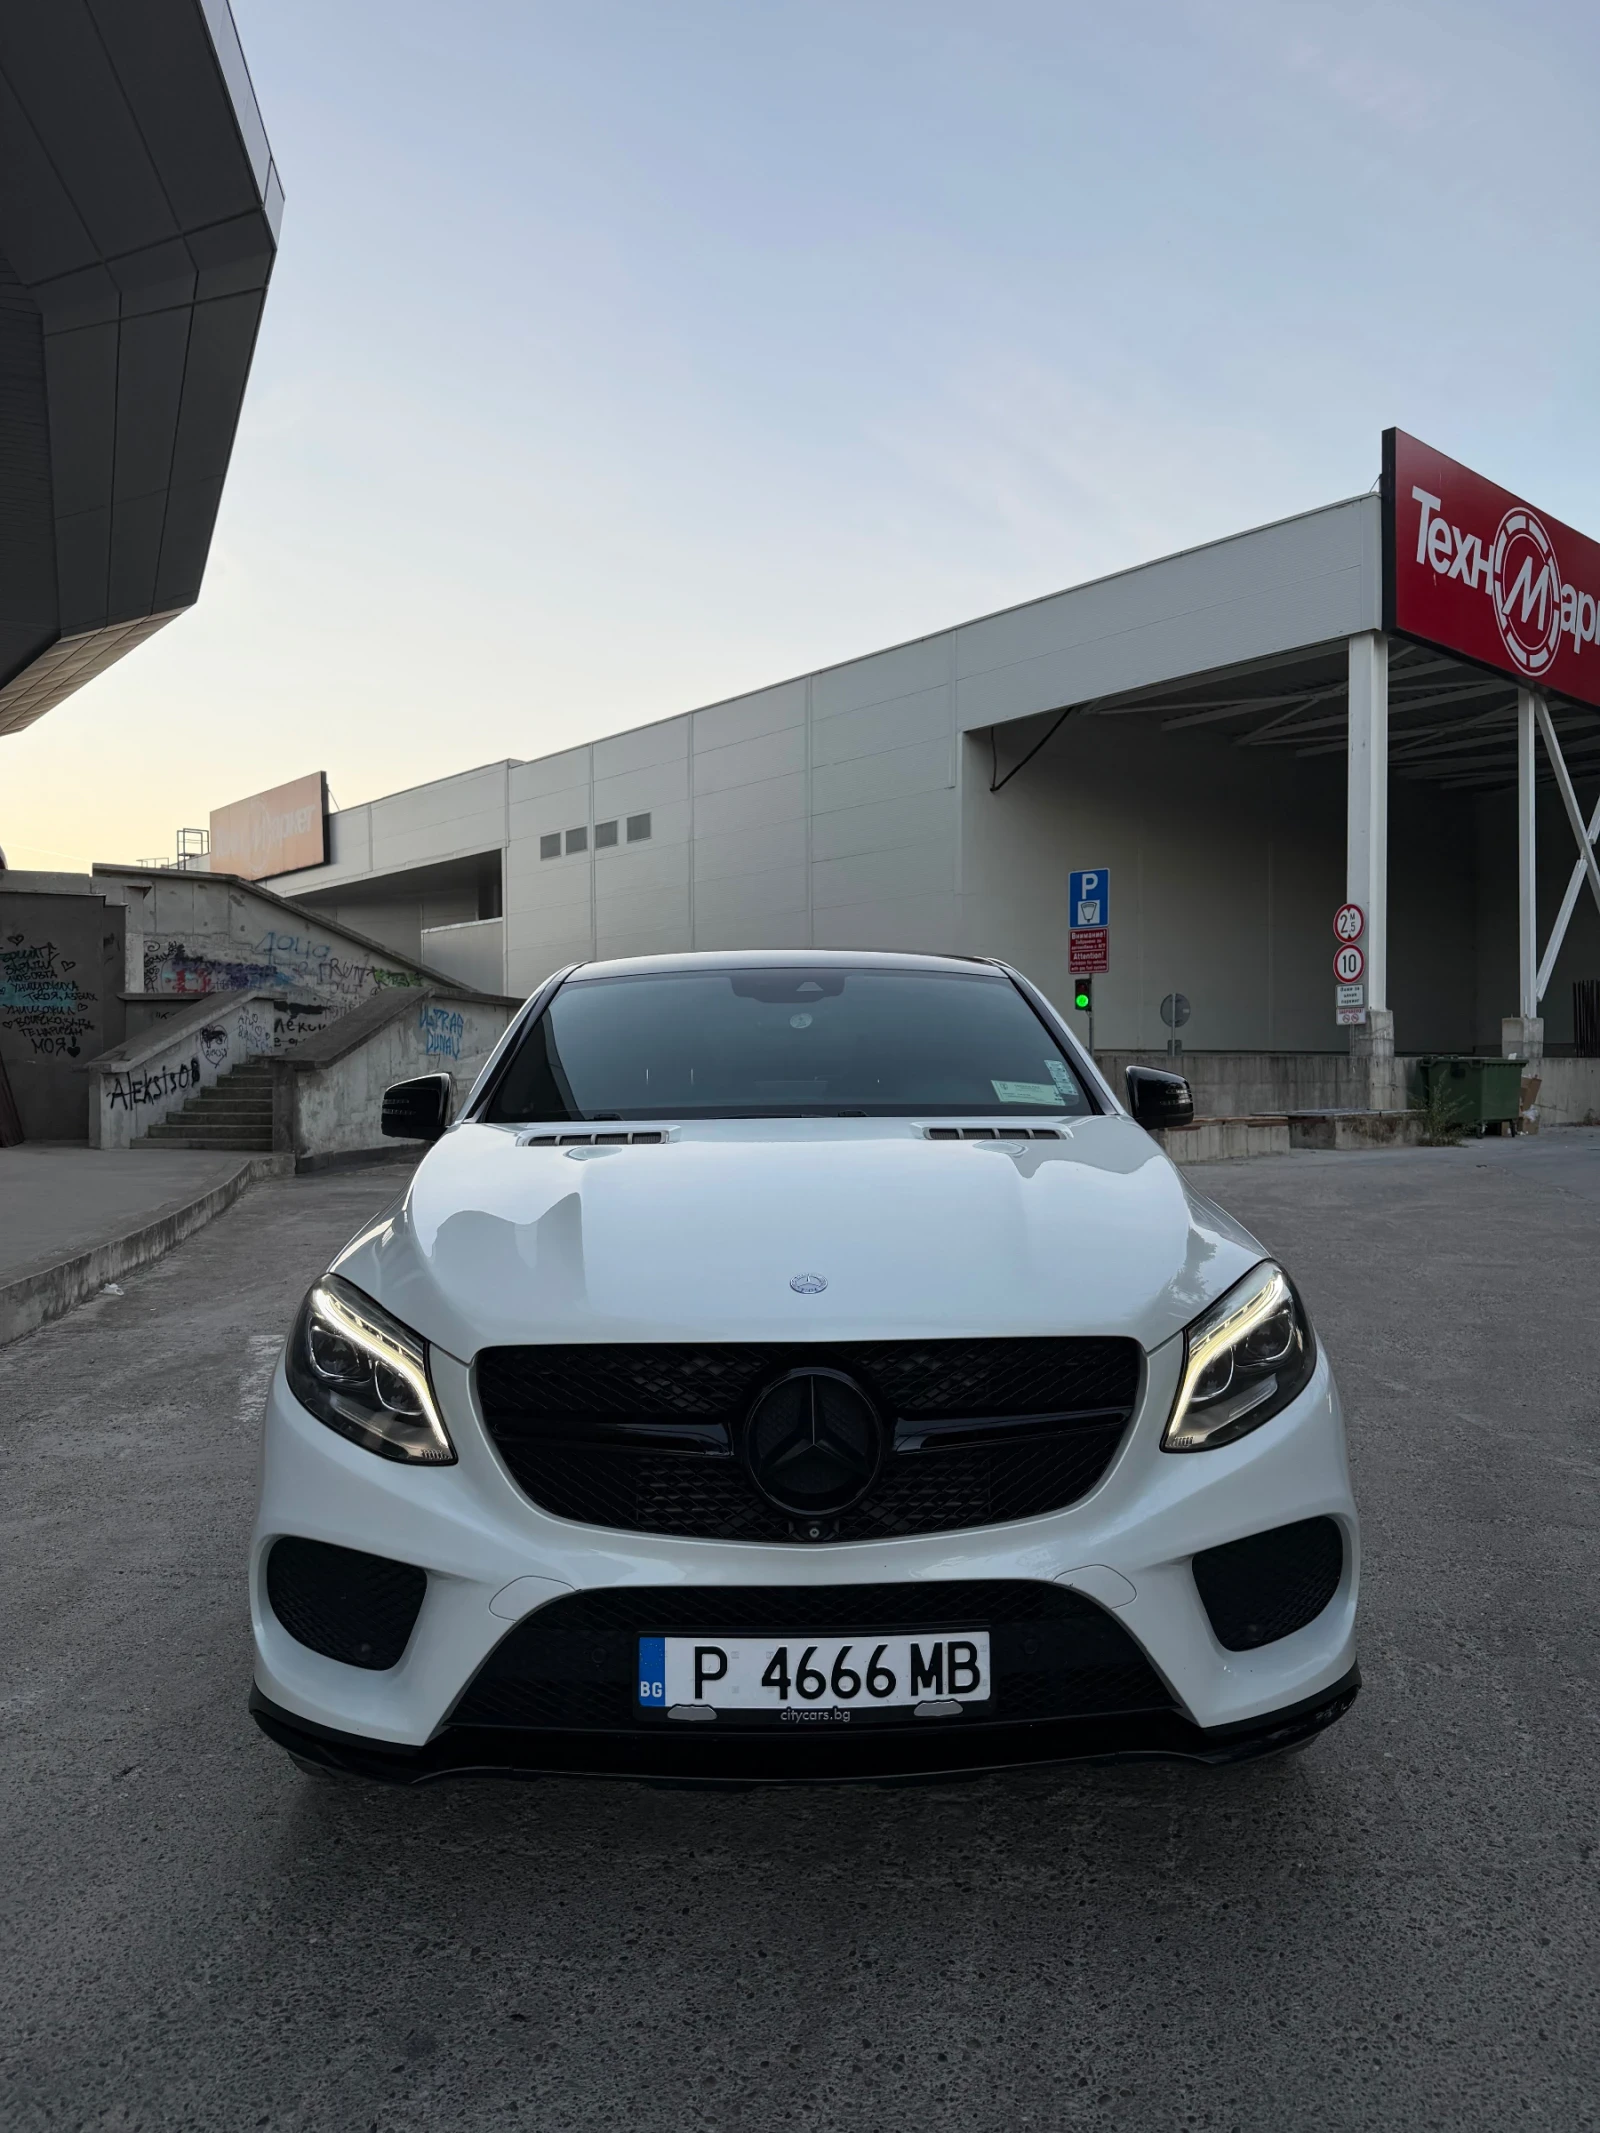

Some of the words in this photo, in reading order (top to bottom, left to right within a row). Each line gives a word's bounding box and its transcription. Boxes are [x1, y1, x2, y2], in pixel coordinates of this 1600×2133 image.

[1081, 873, 1099, 900] P
[1071, 929, 1106, 940] Внимание!
[1073, 951, 1105, 960] Attention!
[1342, 953, 1357, 974] 10
[694, 1645, 728, 1700] P
[761, 1643, 897, 1701] 4666
[910, 1640, 981, 1697] MB
[639, 1681, 663, 1698] BG
[780, 1707, 851, 1723] citycars.bg
